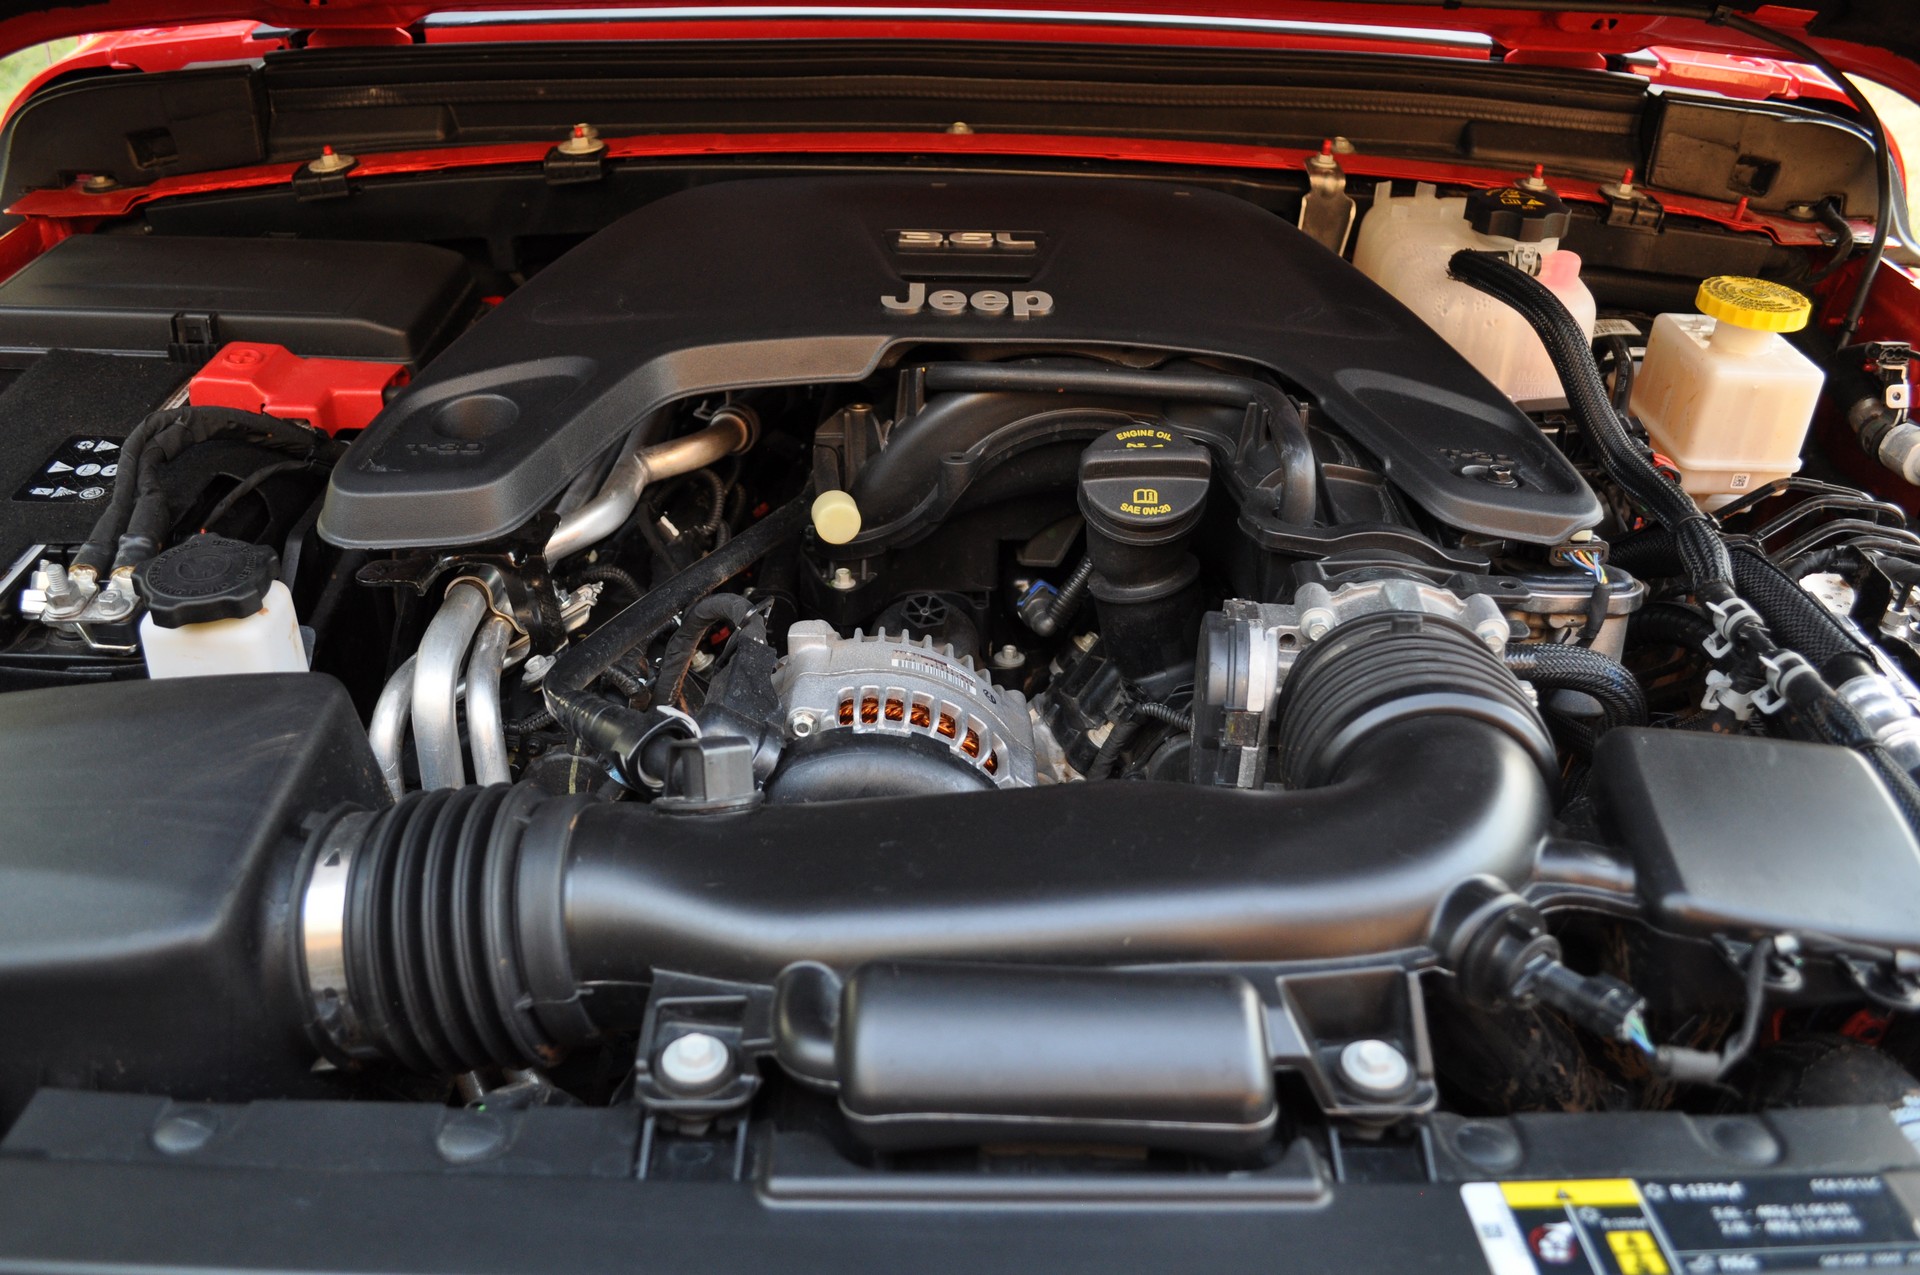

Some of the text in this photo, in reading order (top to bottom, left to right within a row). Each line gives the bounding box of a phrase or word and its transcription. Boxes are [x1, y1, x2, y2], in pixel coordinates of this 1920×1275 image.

[880, 282, 1054, 321] Jeep
[1116, 429, 1172, 441] ENGINE OIL
[1120, 502, 1172, 515] SAE 0W-20
